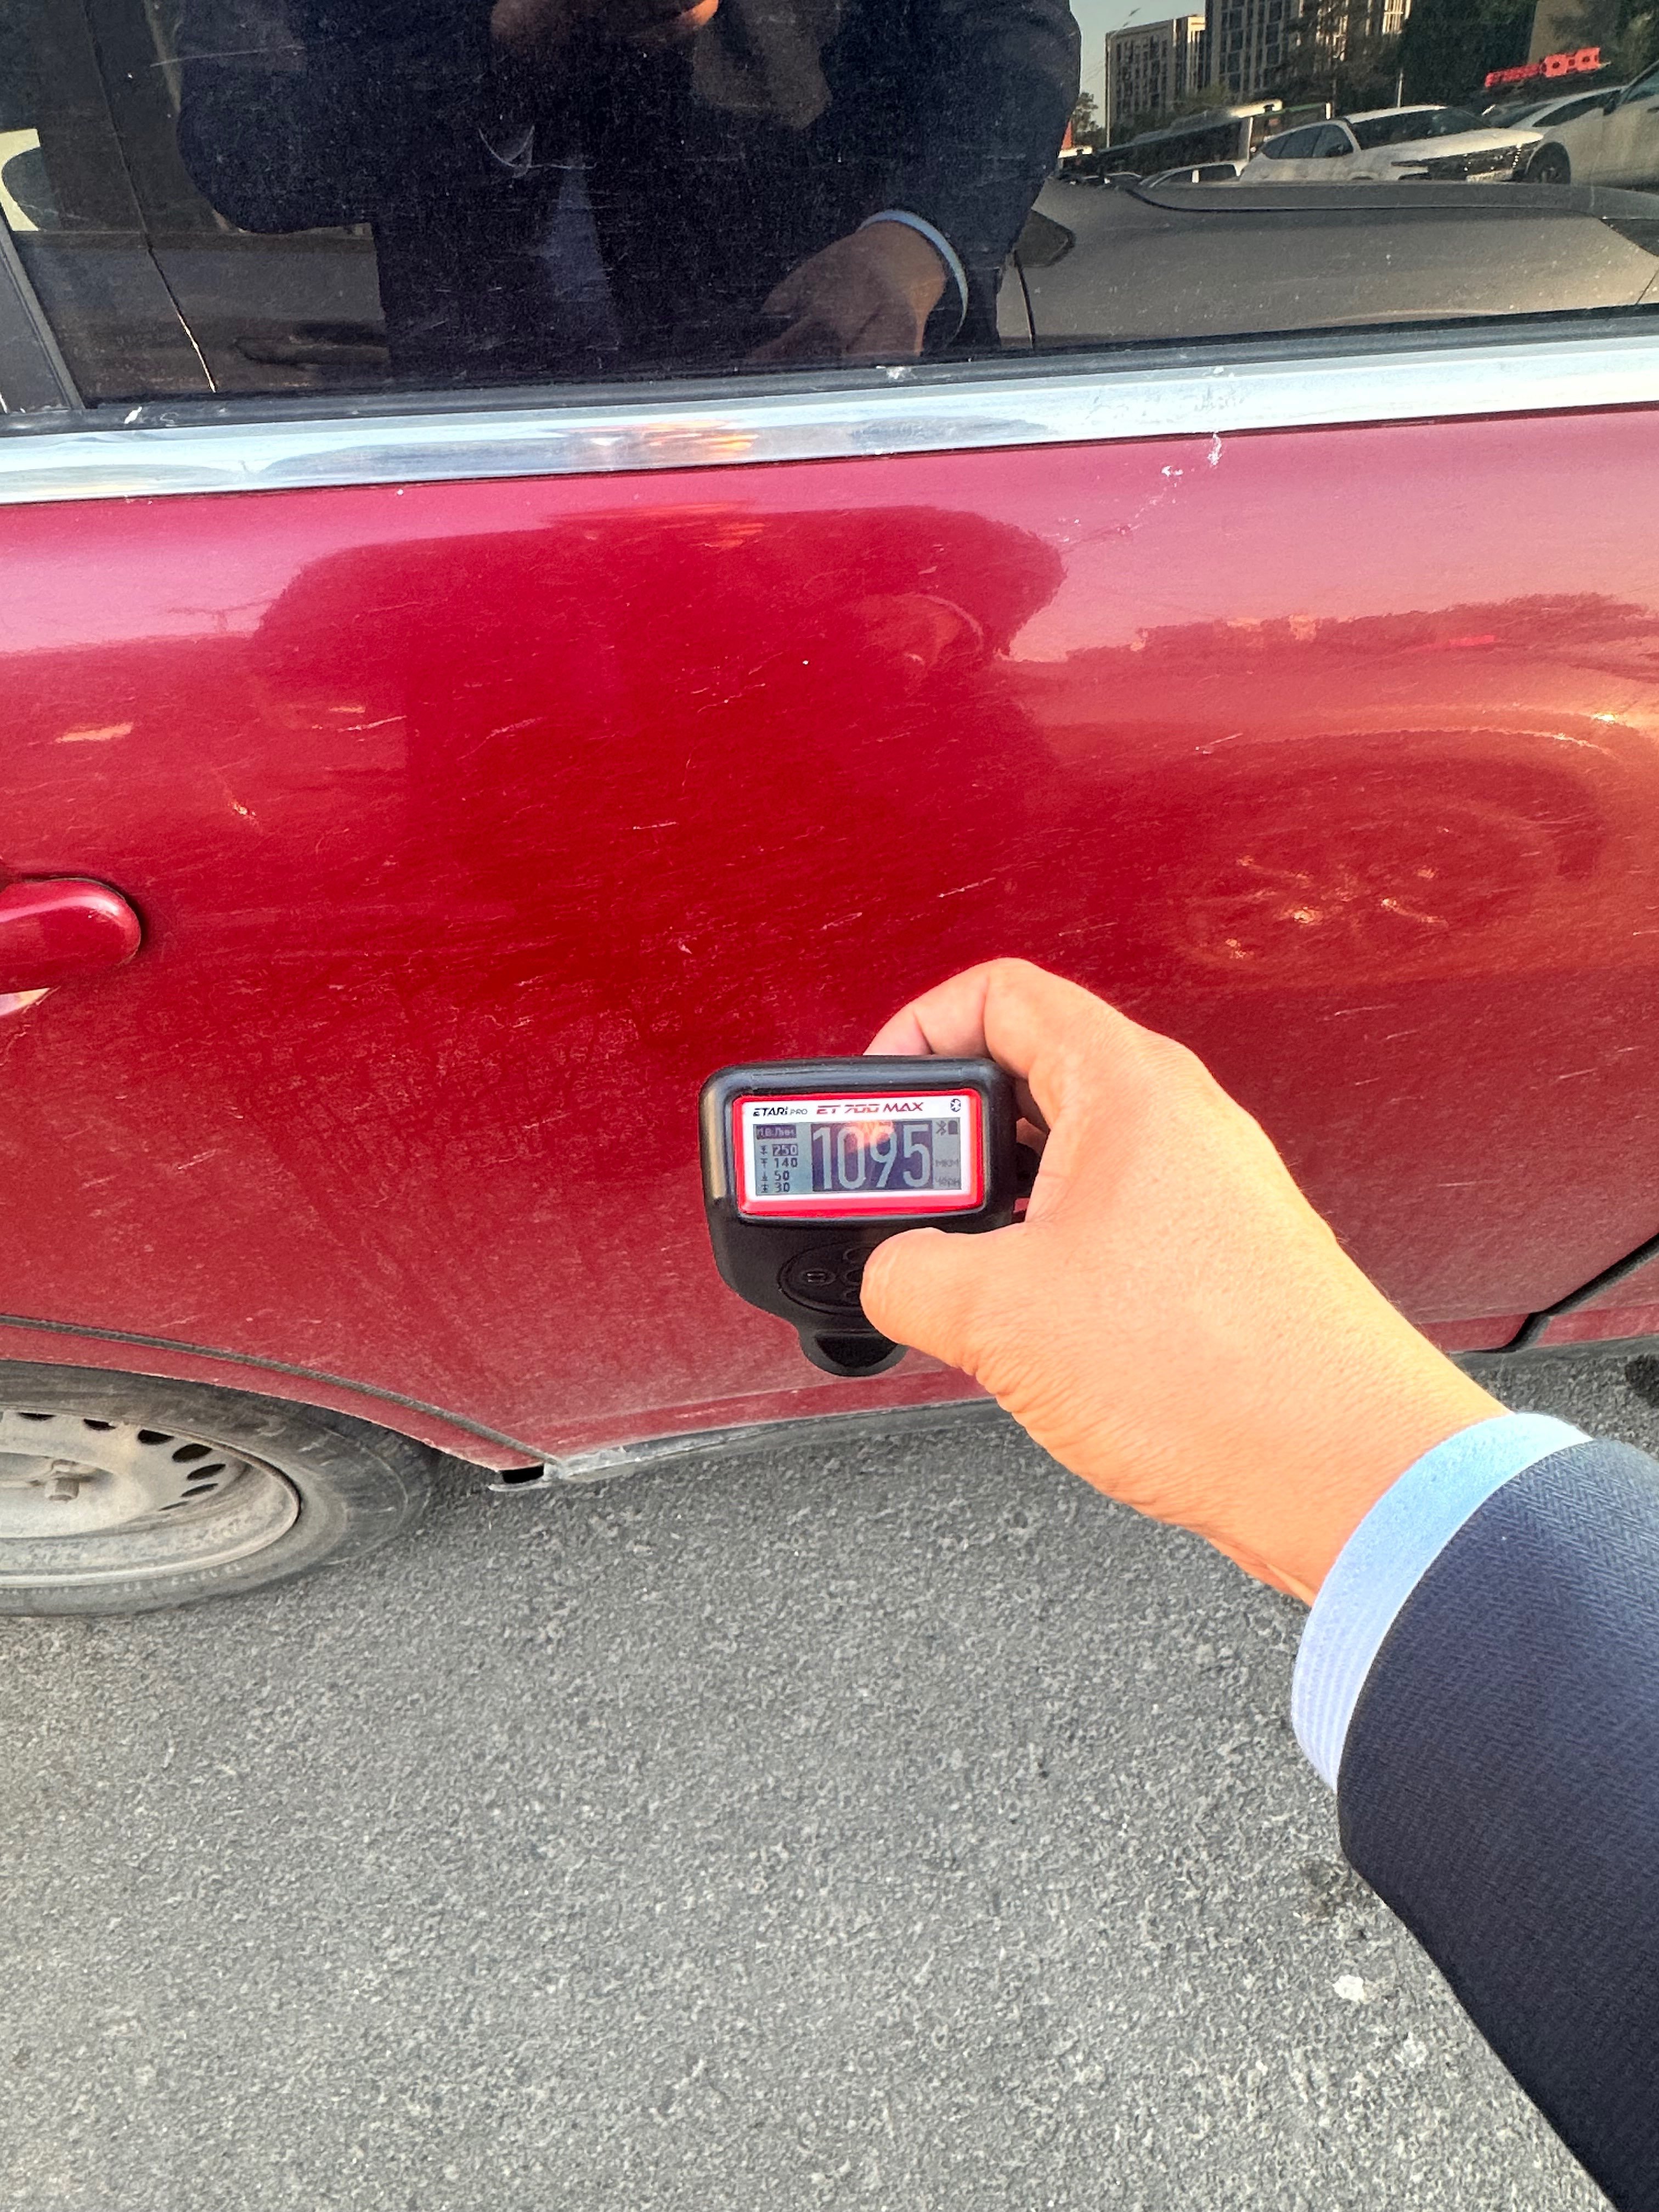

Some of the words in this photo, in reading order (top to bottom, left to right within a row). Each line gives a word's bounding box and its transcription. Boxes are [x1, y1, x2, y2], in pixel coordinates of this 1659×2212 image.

[816, 1105, 841, 1114] ET
[844, 1104, 880, 1113] 700
[883, 1102, 924, 1113] MAX
[773, 1144, 798, 1155] 250
[813, 1124, 930, 1190] 1095
[774, 1158, 798, 1168] 140
[774, 1170, 789, 1181] 50
[775, 1182, 790, 1192] 30
